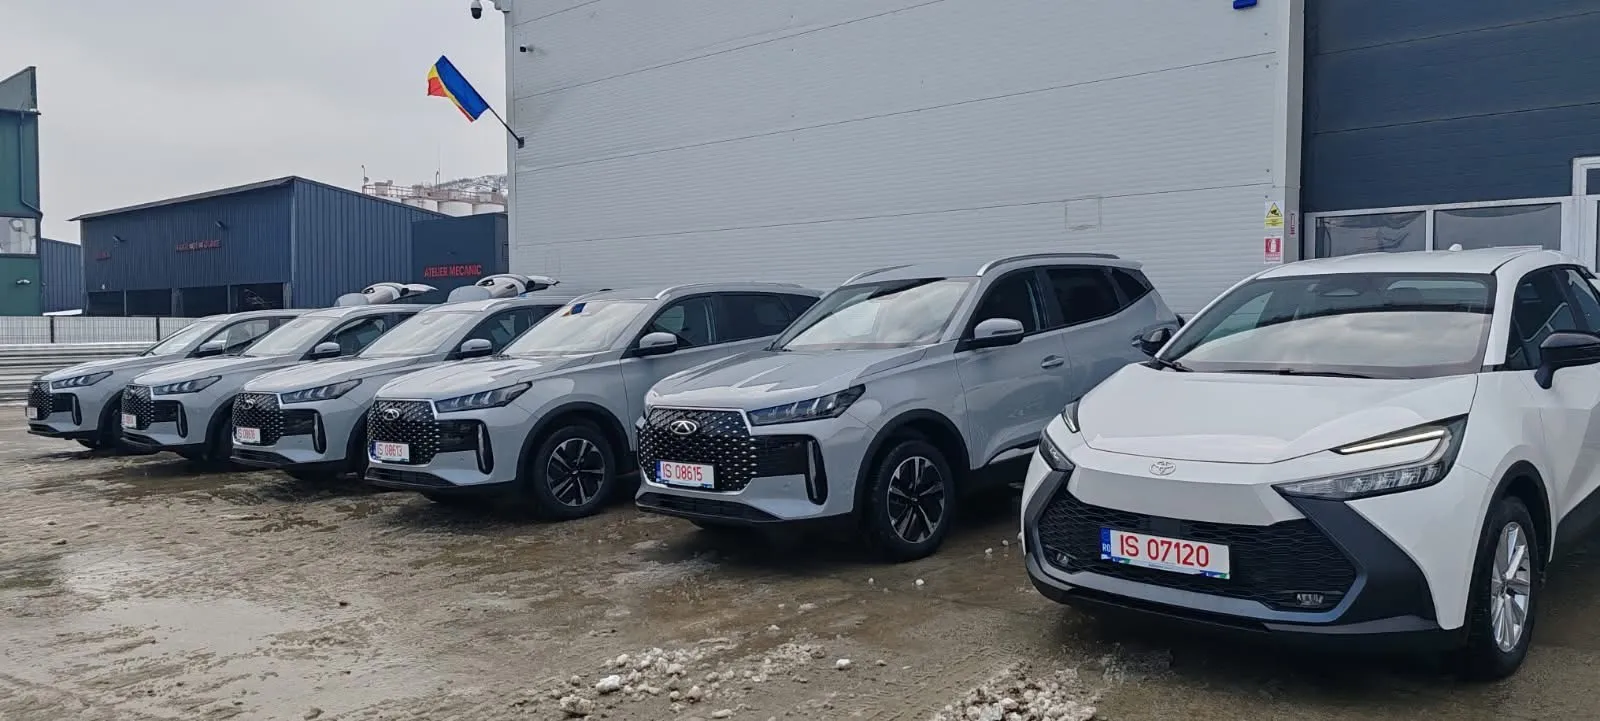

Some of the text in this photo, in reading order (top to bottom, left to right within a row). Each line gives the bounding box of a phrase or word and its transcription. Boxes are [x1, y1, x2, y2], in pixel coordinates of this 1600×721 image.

[424, 264, 482, 277] ATELIER MECANIC
[662, 463, 672, 478] IS
[675, 464, 703, 481] 08615
[1102, 543, 1111, 552] RO
[1120, 534, 1209, 567] IS 07120
